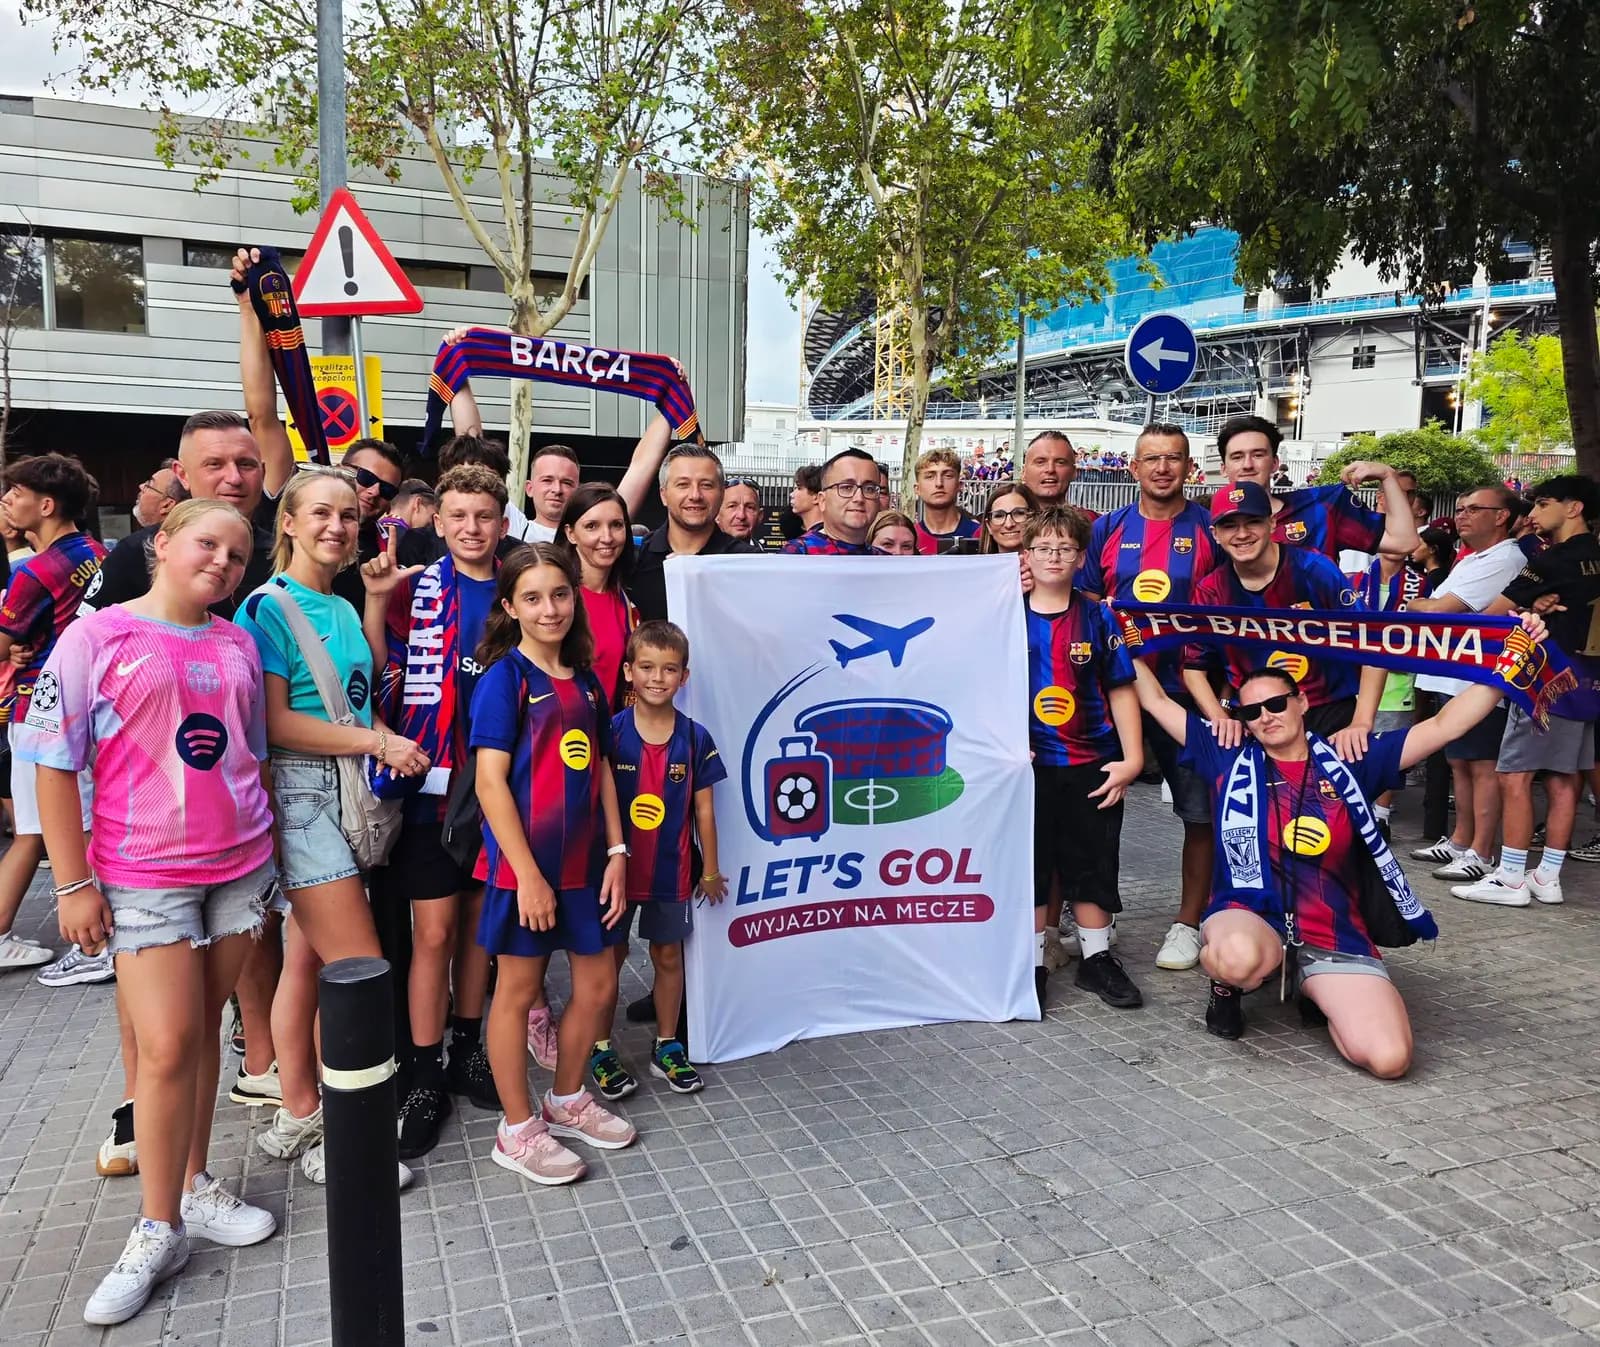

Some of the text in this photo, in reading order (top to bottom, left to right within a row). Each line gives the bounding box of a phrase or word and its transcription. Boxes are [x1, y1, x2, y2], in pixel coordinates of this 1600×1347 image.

[510, 335, 631, 383] BARÇA
[1145, 612, 1198, 636] FC
[1206, 615, 1483, 665] BARCELONA
[403, 625, 444, 705] UEFA
[461, 657, 486, 675] Sp
[735, 847, 983, 906] LET'S GOL
[744, 901, 977, 939] WYJAZDY NA MECZE
